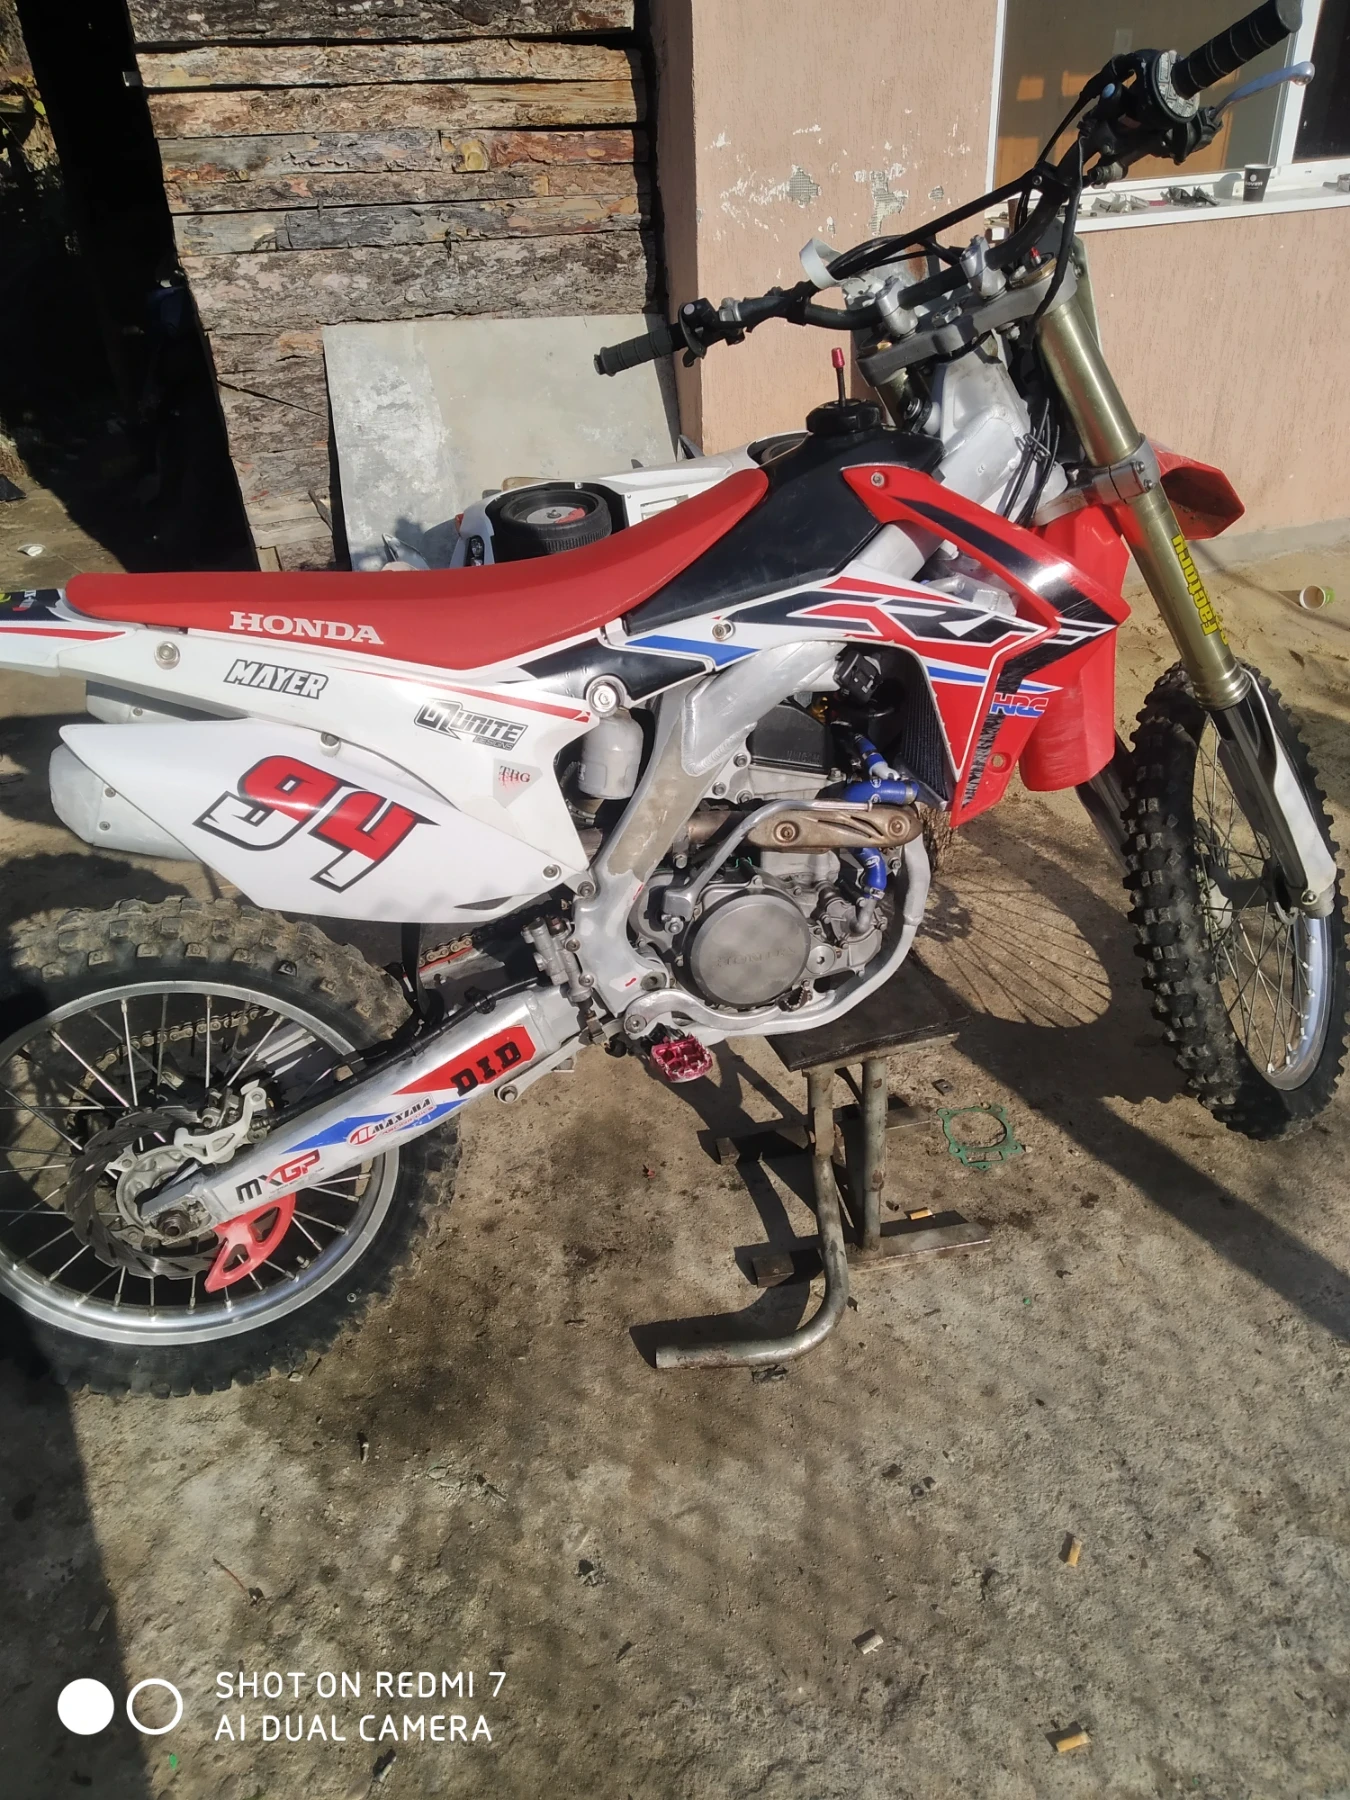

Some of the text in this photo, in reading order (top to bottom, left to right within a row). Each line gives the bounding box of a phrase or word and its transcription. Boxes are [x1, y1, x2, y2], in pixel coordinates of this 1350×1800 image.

[229, 611, 384, 645] HONDA
[223, 659, 329, 700] MAYER
[989, 692, 1049, 718] HRC
[192, 755, 440, 893] 94
[371, 1098, 431, 1133] MAXIMA
[235, 1150, 320, 1204] MXGP
